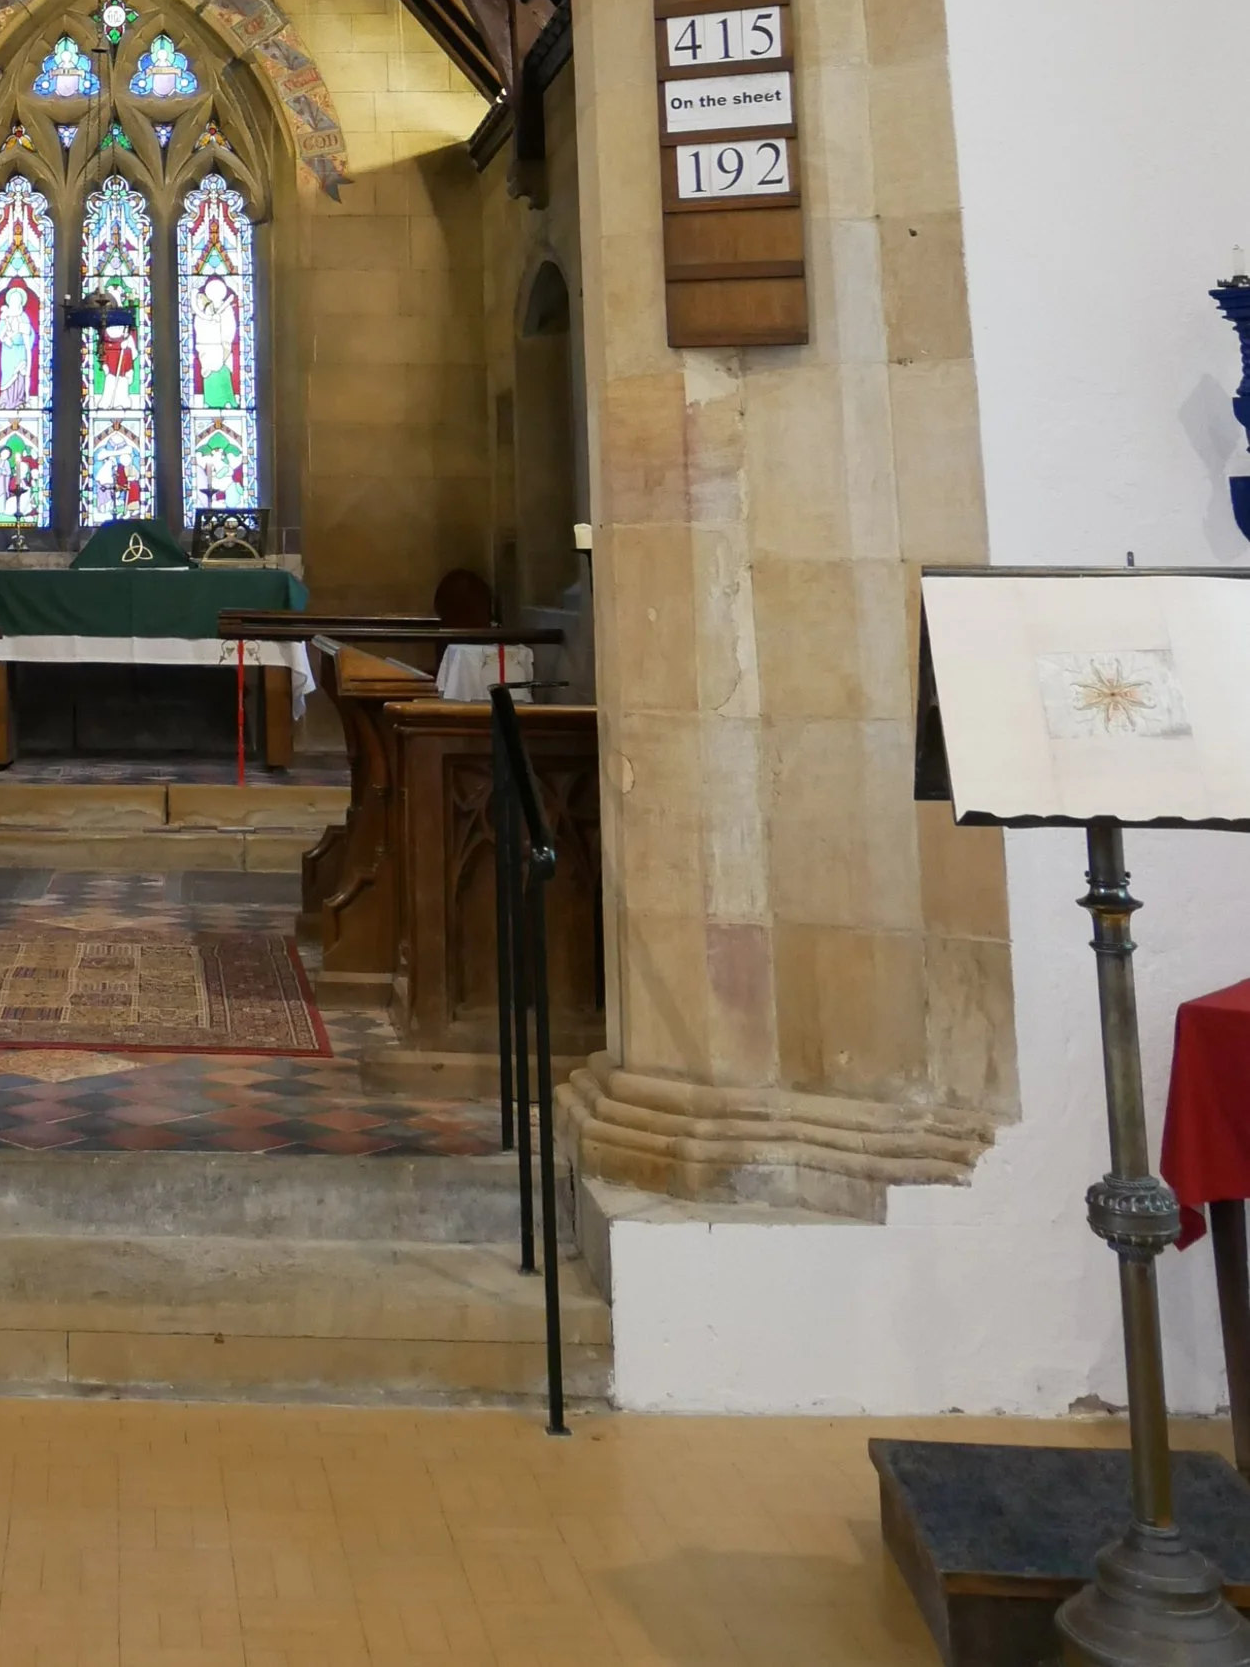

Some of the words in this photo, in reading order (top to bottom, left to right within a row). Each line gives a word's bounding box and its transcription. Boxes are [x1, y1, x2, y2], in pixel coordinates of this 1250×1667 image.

[674, 14, 773, 60] 415
[671, 98, 693, 109] On
[699, 95, 727, 107] the
[733, 90, 782, 104] sheet
[688, 142, 784, 193] 192
